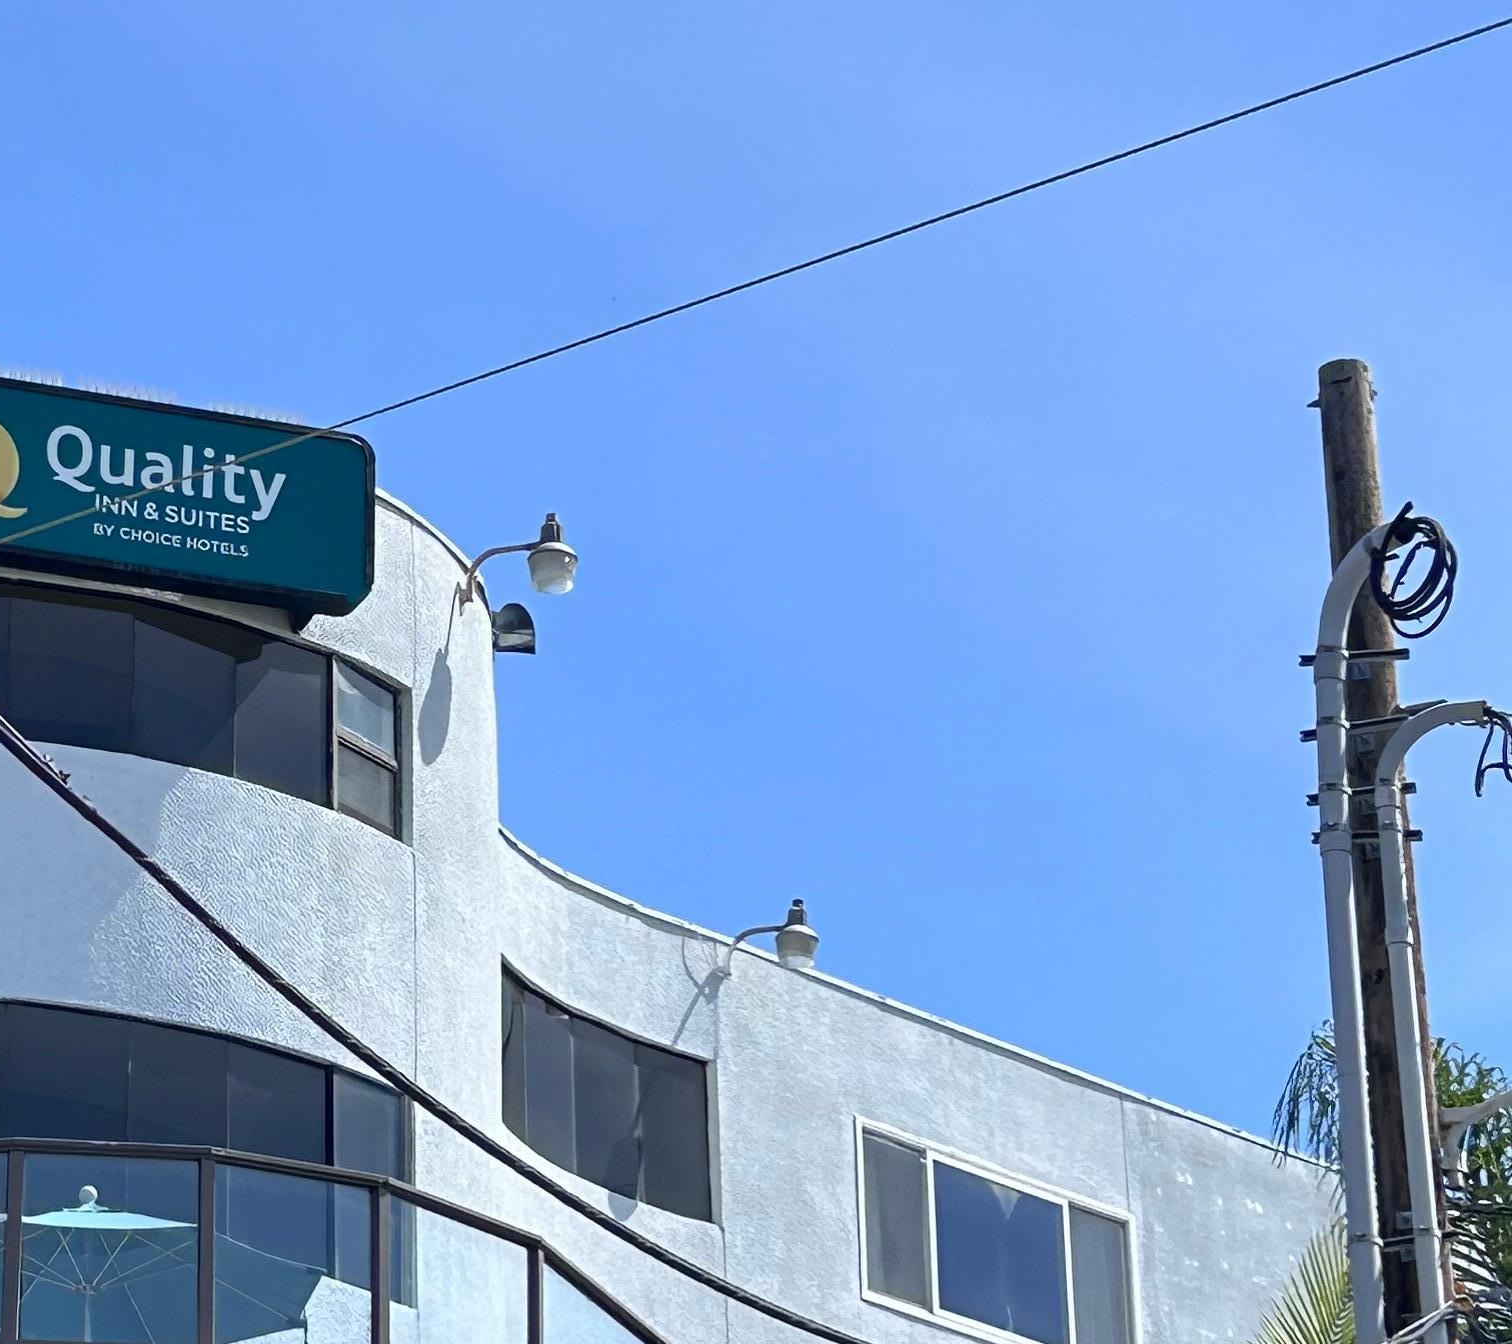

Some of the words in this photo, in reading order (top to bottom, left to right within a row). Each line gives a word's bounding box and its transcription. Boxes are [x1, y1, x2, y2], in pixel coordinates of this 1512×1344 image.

[46, 425, 287, 521] Quality
[94, 494, 138, 518] INN
[143, 502, 159, 521] &
[164, 505, 251, 534] SUITES
[93, 523, 115, 537] BY
[119, 527, 182, 548] CHOICE
[186, 537, 250, 557] HOTELS
